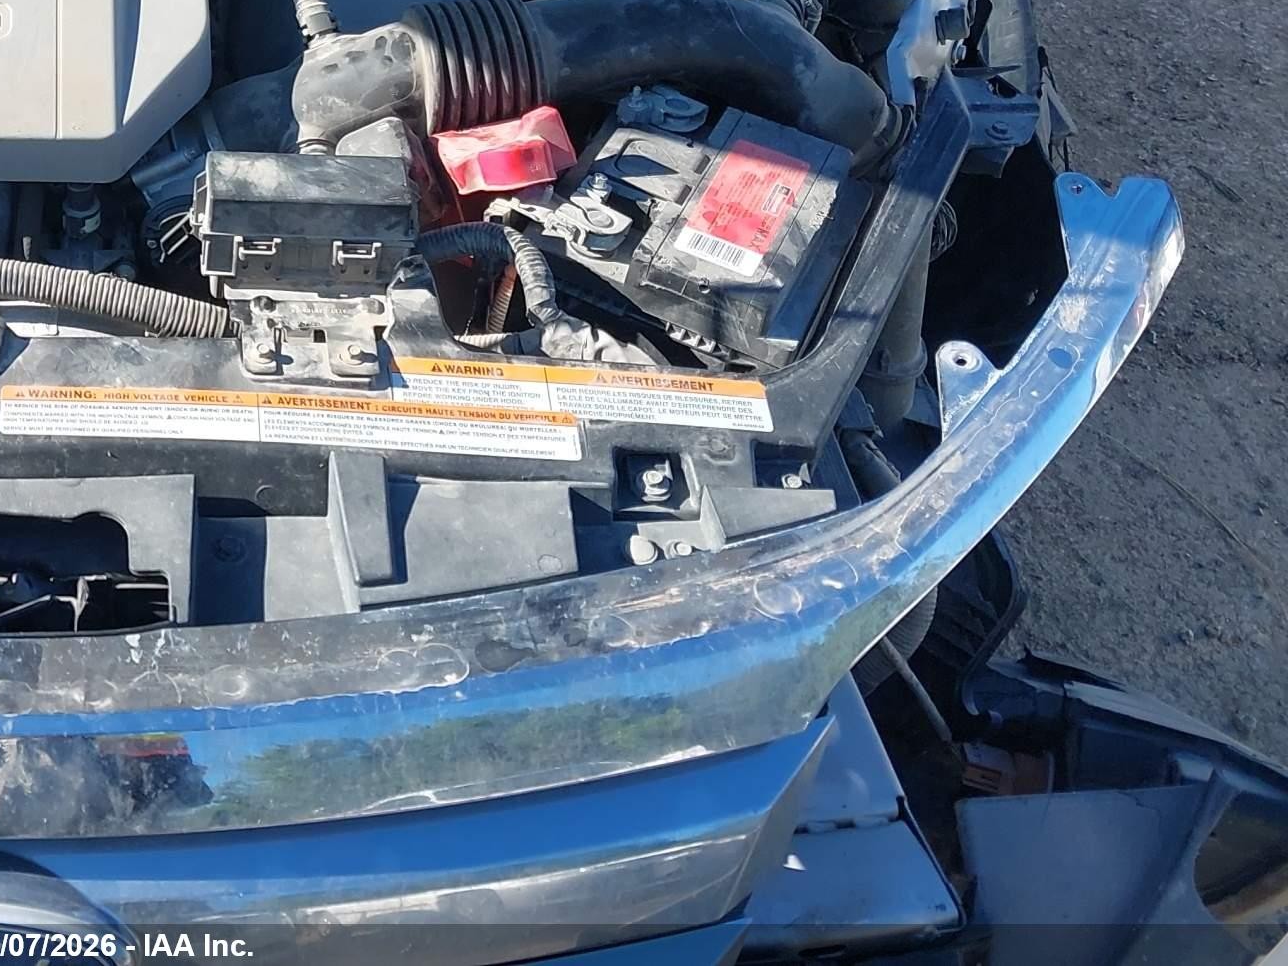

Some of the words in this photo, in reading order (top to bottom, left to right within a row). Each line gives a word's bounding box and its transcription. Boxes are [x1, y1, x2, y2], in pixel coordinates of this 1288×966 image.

[444, 364, 504, 377] WARNING
[610, 375, 714, 391] AVERTISSEMENT
[28, 389, 96, 399] WARNING:
[132, 393, 180, 401] VOLTAGE
[184, 394, 228, 402] VEHICLE
[277, 397, 371, 411] AVERTISSEMENT
[381, 404, 422, 414] CIRCUITS
[424, 408, 454, 416] HAUTE
[456, 410, 496, 420] TENSION
